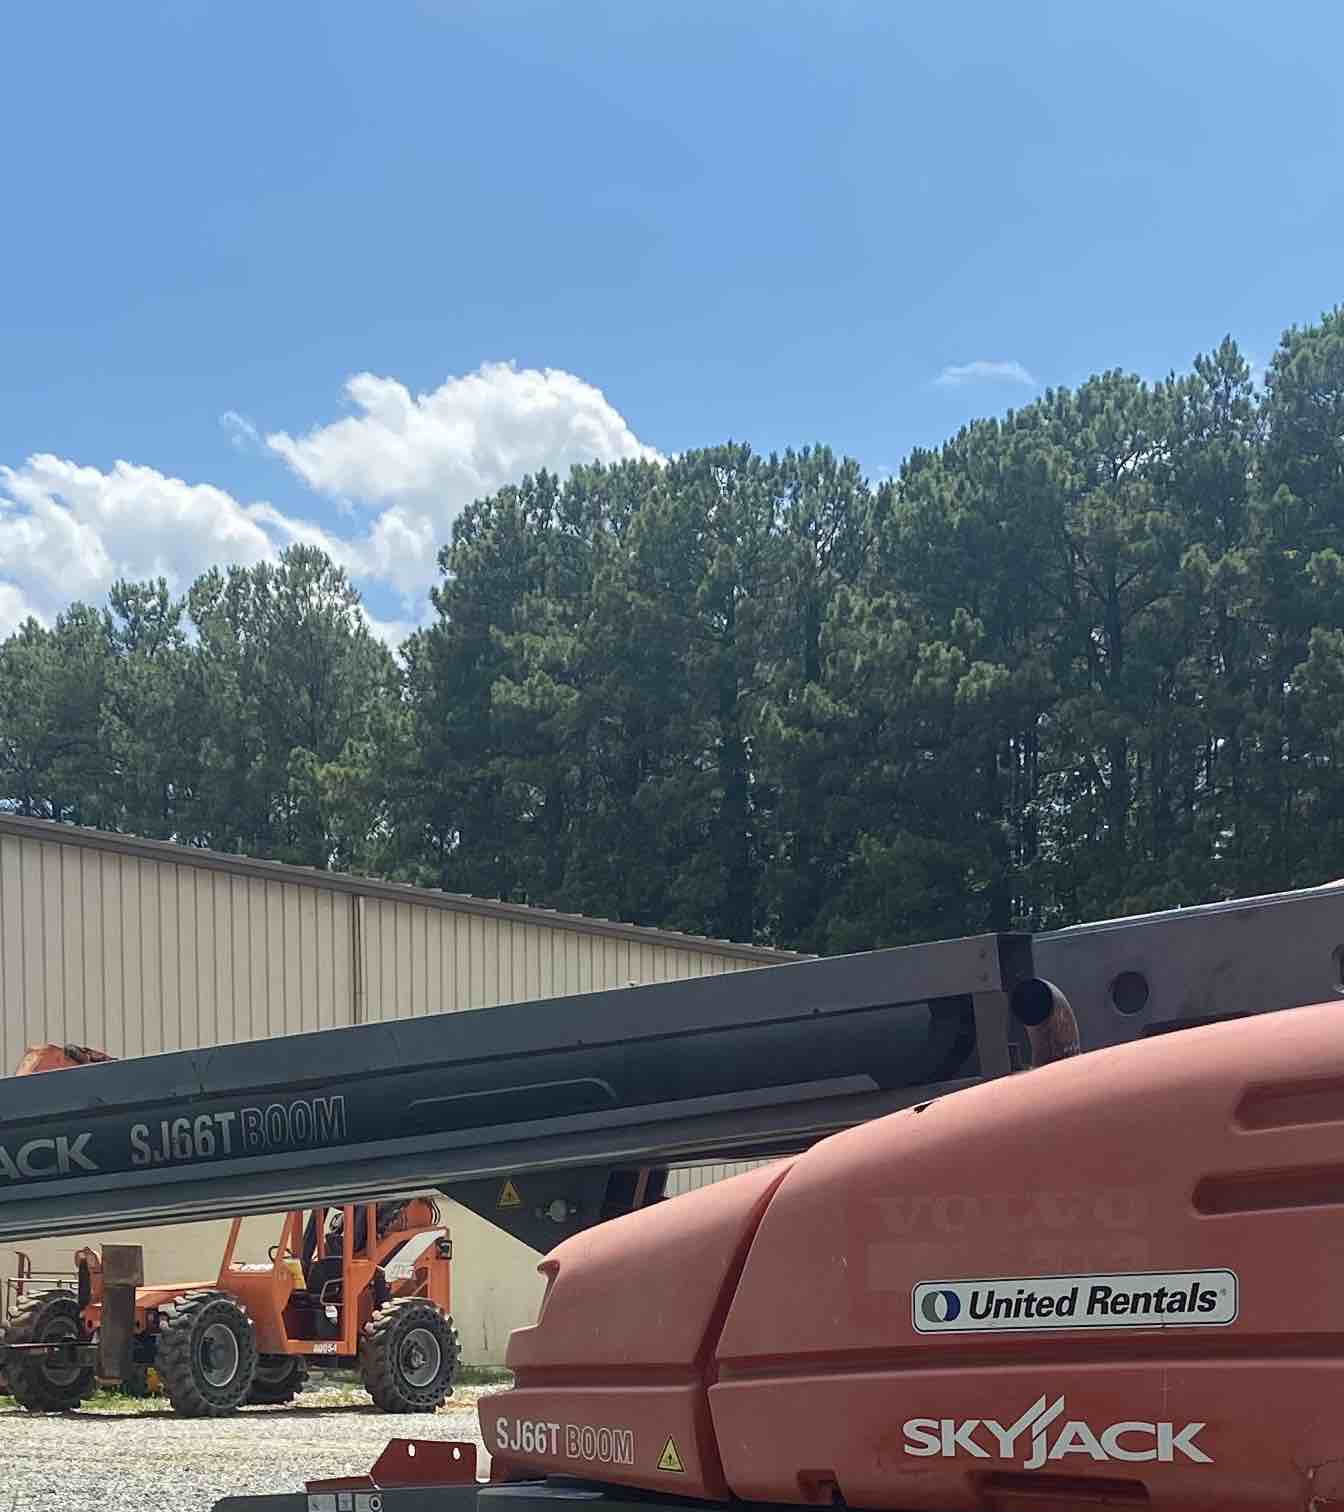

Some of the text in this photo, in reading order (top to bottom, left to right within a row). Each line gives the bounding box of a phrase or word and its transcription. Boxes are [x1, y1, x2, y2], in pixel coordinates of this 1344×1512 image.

[130, 1095, 348, 1165] SJ66T BOOM
[969, 1282, 1218, 1320] United Rentals
[496, 1417, 635, 1465] SJ66T BOOM
[902, 1393, 1216, 1470] SKYJACK
